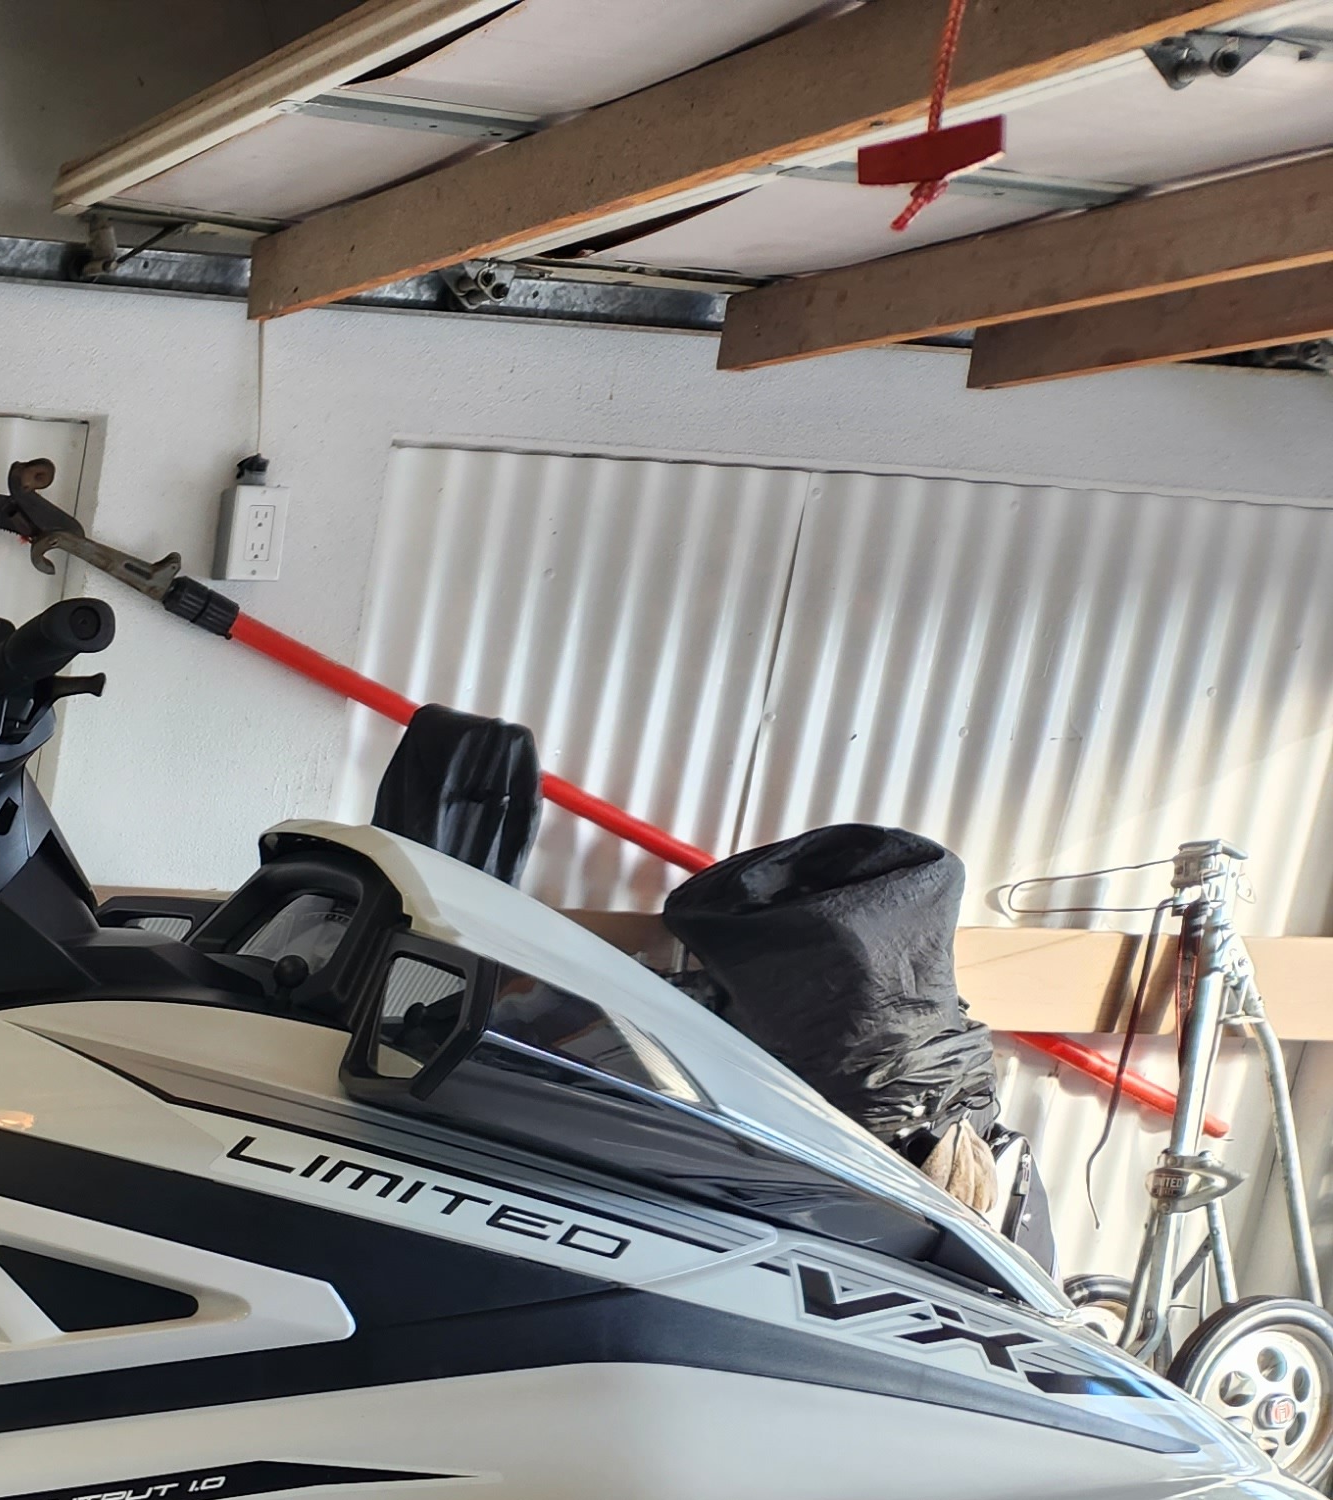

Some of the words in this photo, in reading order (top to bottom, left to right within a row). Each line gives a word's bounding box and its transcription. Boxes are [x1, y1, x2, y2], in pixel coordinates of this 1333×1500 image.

[226, 1135, 632, 1259] LIMITED
[793, 1260, 1051, 1378] VX
[188, 1475, 226, 1493] 1.0
